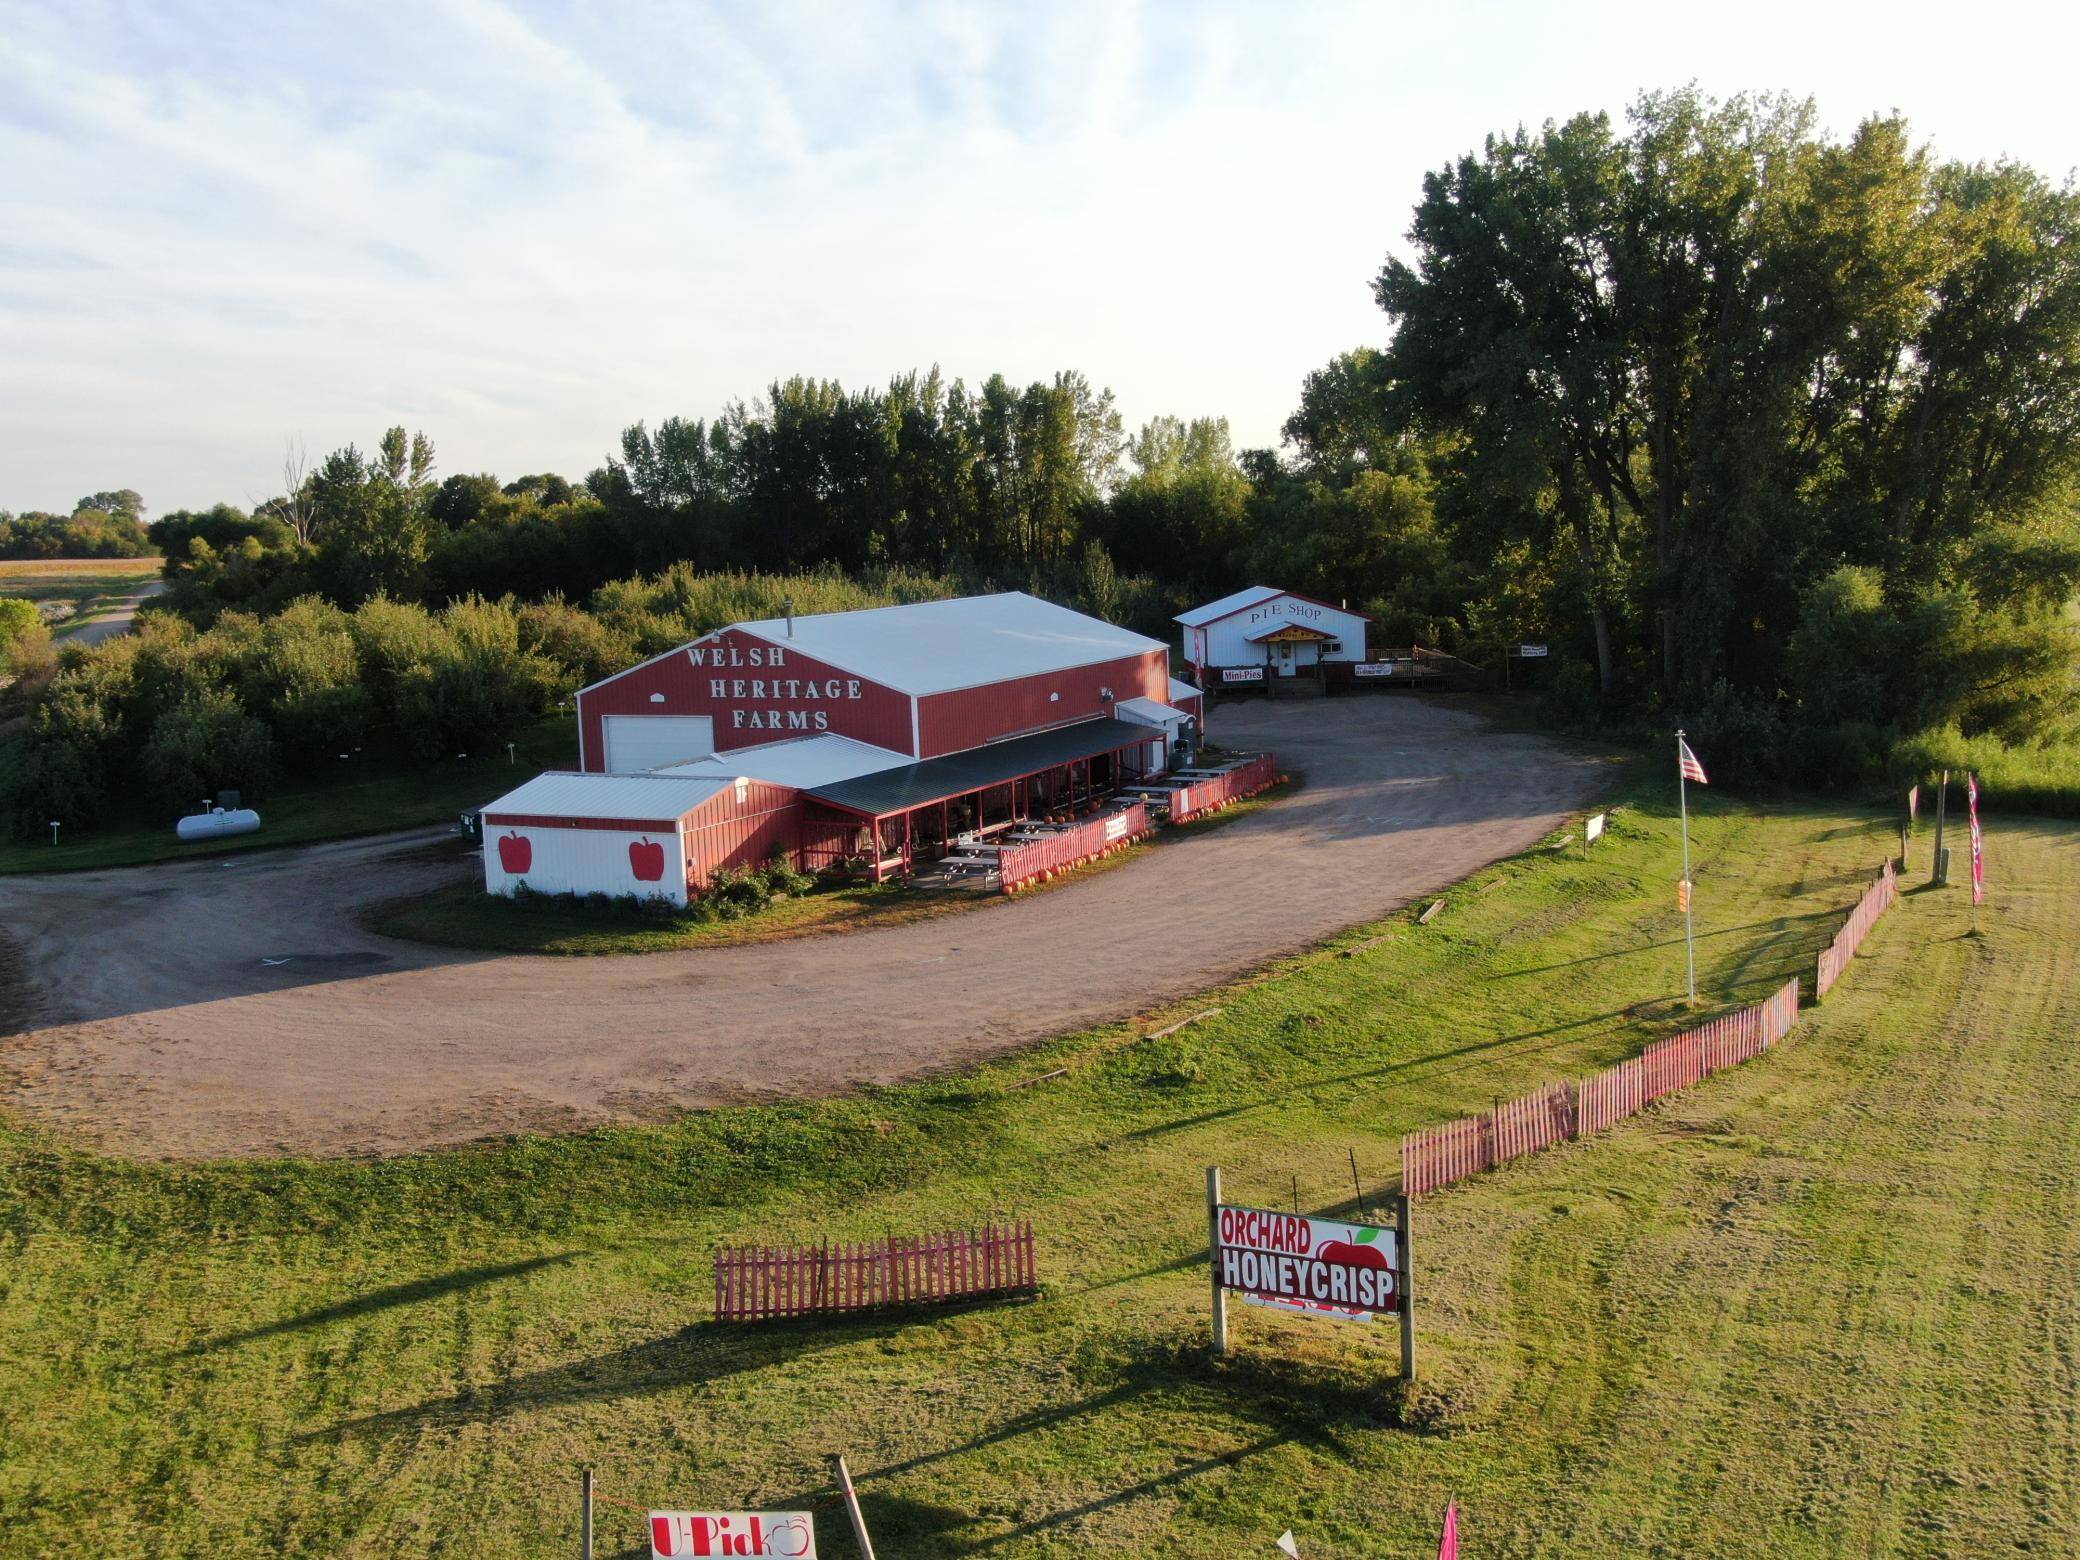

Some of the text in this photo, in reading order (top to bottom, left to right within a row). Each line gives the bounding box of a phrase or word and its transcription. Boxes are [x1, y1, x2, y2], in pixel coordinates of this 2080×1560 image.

[1251, 603, 1321, 623] PIE SHOP
[686, 648, 786, 667] WELSH
[1224, 670, 1262, 680] Mini-Pies
[710, 679, 862, 699] HERITAGE
[732, 710, 828, 730] FARMS
[1221, 1208, 1311, 1255] ORCHARD
[1222, 1249, 1394, 1307] HONEYCRISP
[651, 1516, 773, 1556] U-Pick
